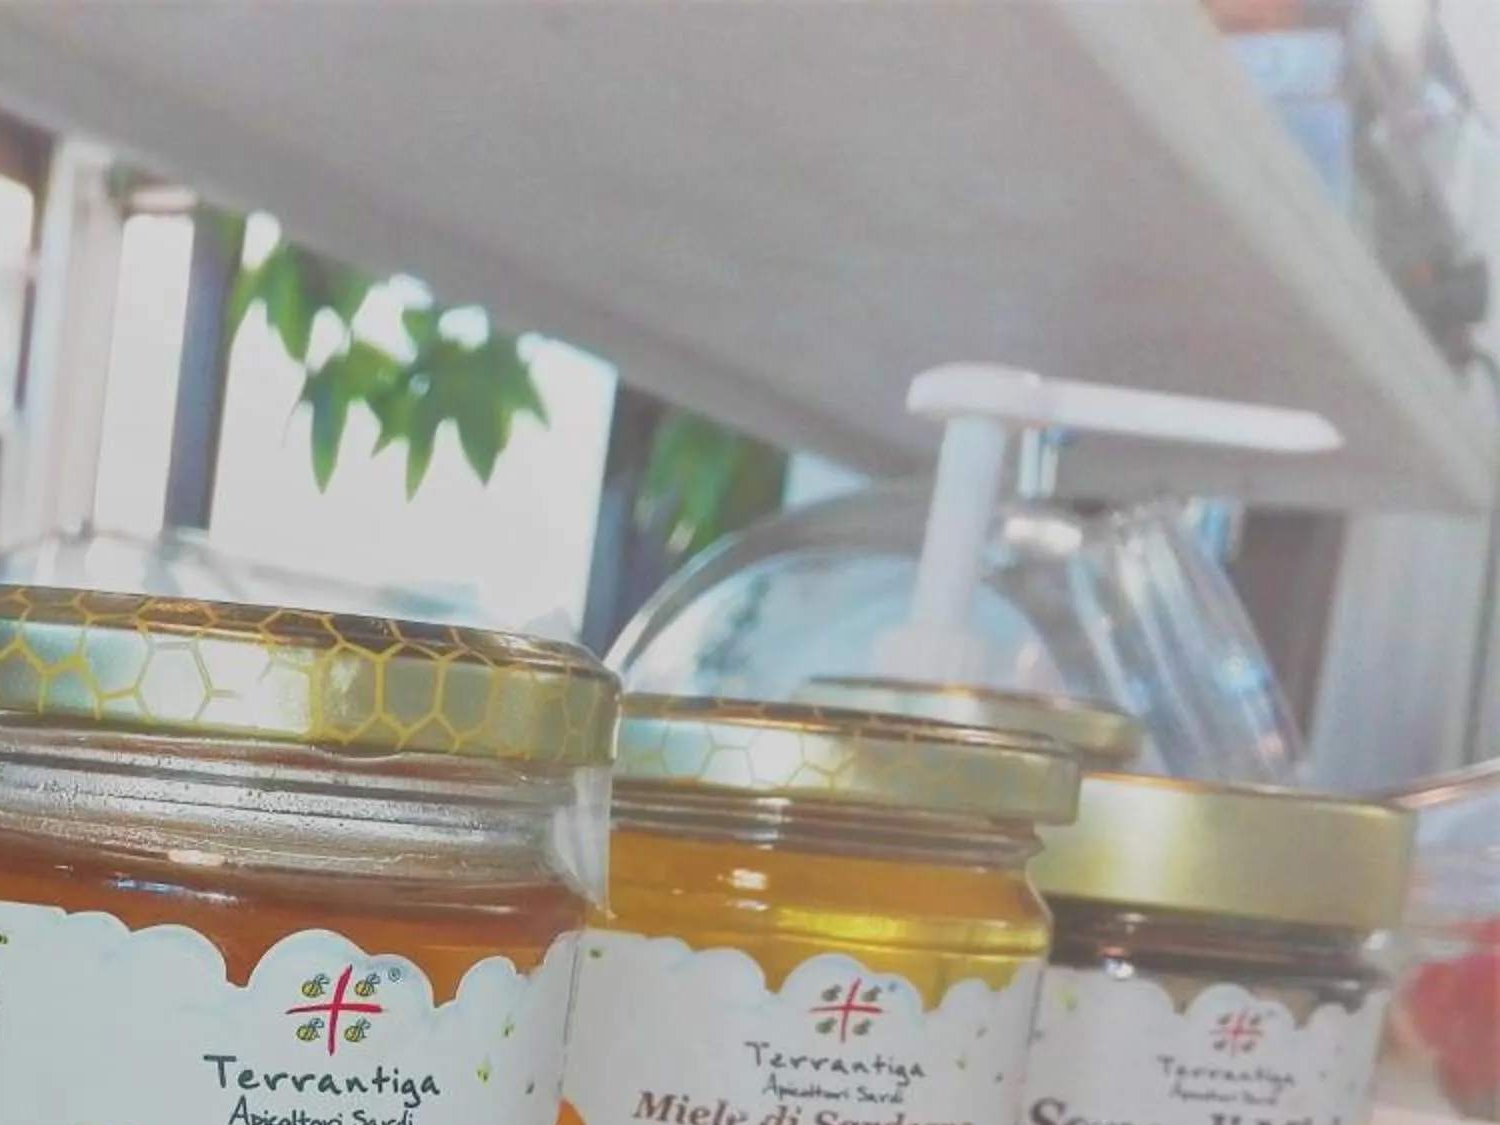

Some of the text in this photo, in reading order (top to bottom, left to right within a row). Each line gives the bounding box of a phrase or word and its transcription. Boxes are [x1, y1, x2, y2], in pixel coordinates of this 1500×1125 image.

[204, 1054, 442, 1109] Terrantiga
[743, 1040, 928, 1088] Terrantiga
[1155, 1054, 1295, 1097] Terrantiga
